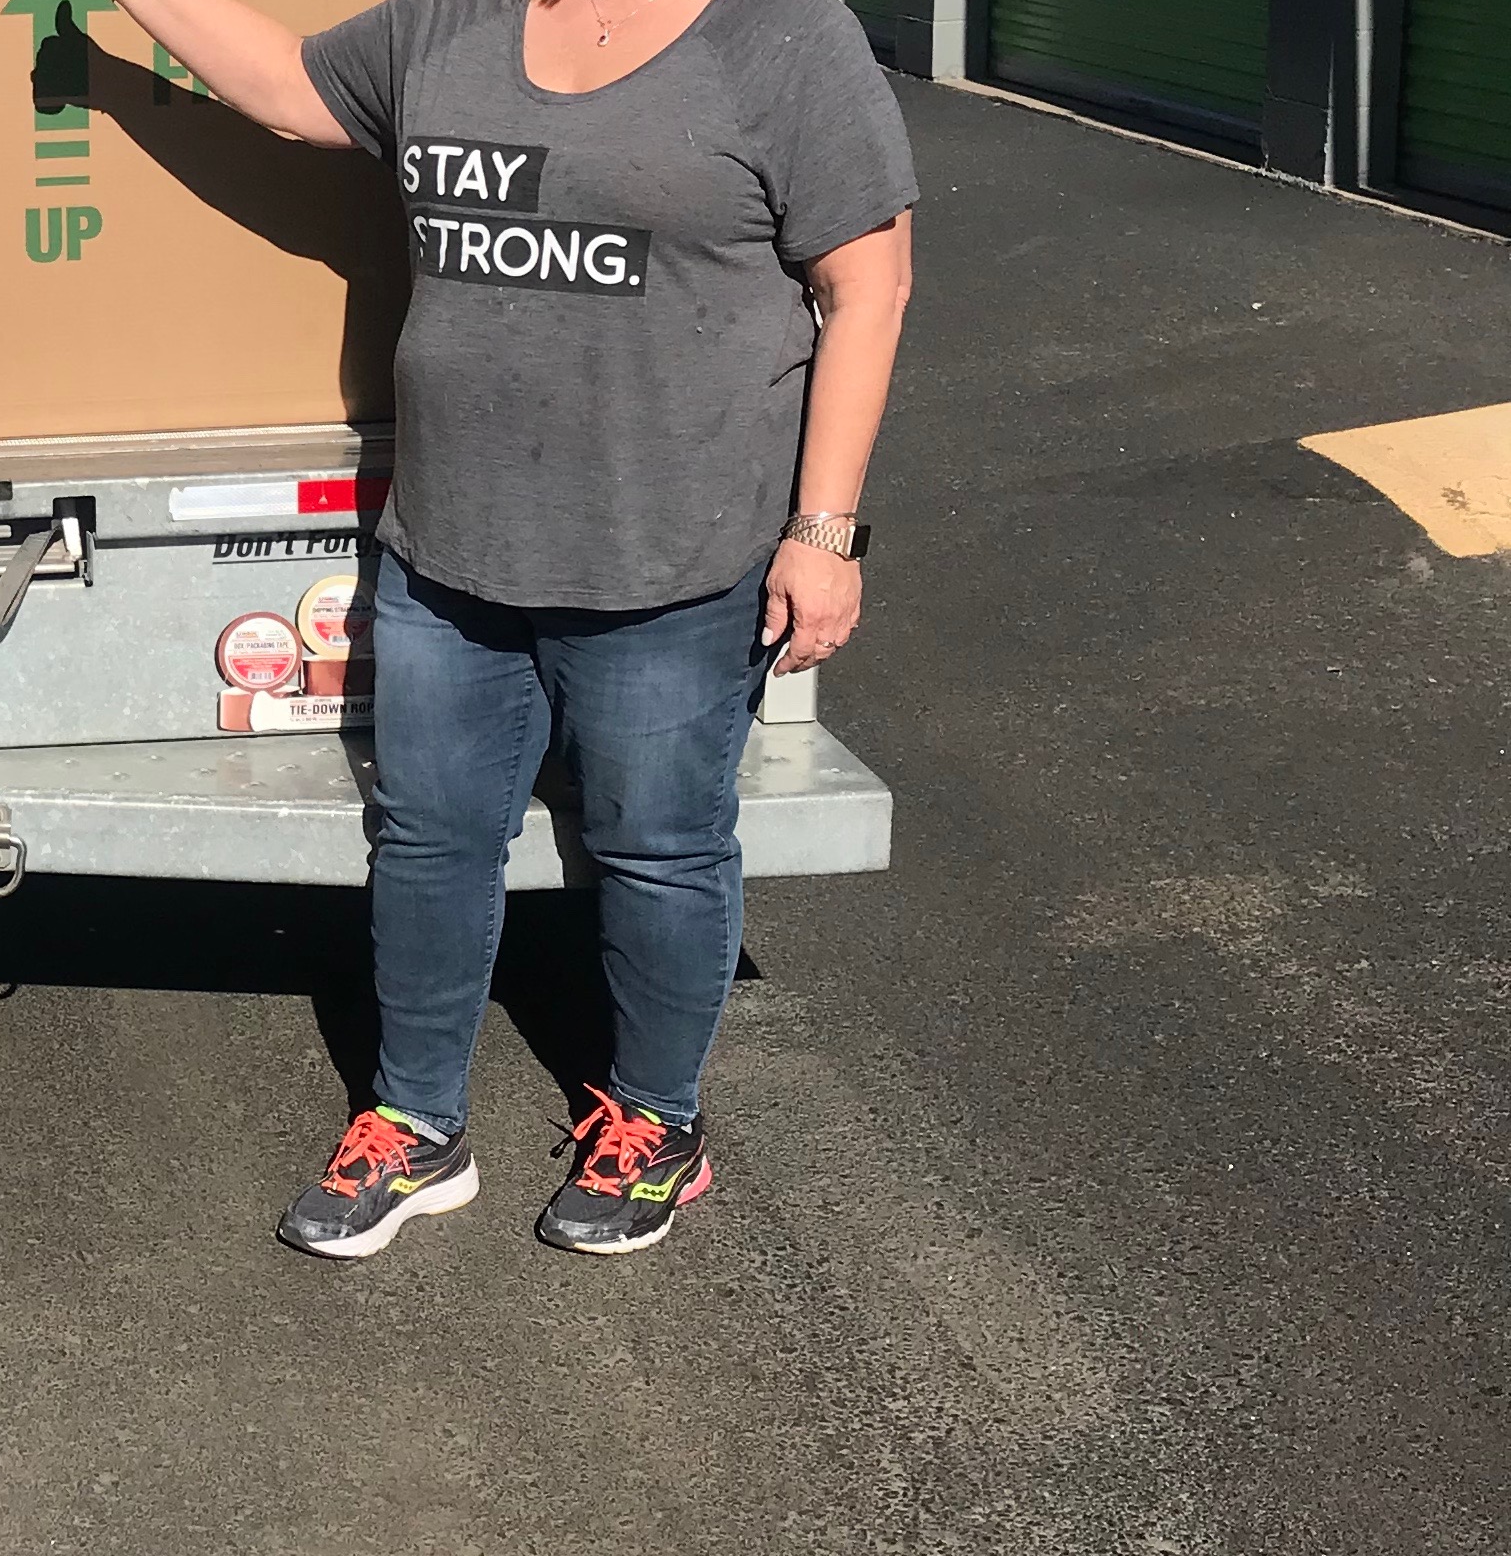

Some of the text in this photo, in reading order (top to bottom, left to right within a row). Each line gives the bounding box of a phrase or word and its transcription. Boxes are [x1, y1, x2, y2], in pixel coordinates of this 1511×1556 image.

[403, 145, 527, 201] STAY
[25, 205, 103, 263] UP
[213, 532, 296, 558] Don't
[290, 702, 374, 716] TIE-DOWN ROP
